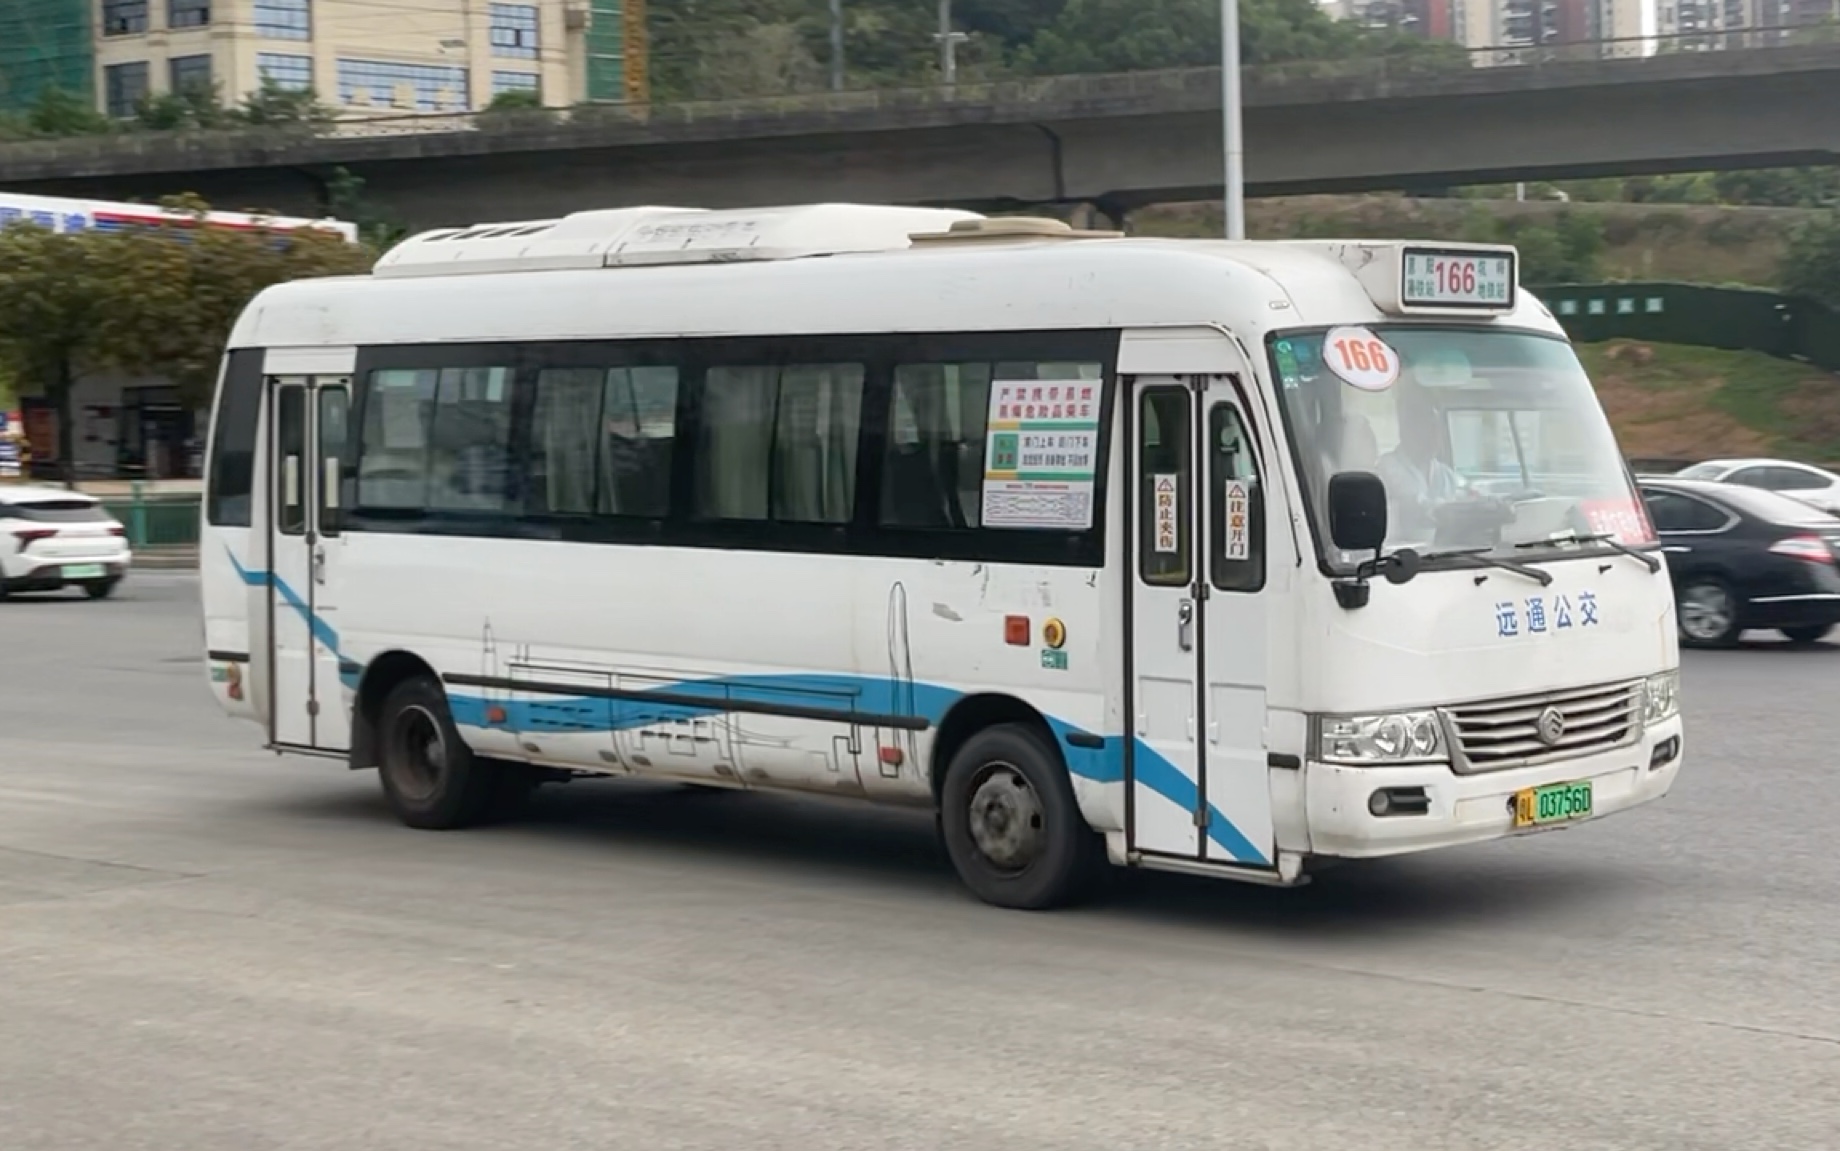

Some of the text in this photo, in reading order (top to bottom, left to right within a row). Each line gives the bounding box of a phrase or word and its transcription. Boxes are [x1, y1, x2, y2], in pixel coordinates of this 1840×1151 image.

[1435, 260, 1475, 294] 166
[1334, 339, 1389, 373] 166
[1158, 494, 1174, 549] 防止夹伤
[1229, 500, 1245, 556] 注意开门
[1495, 591, 1598, 637] 远通公交
